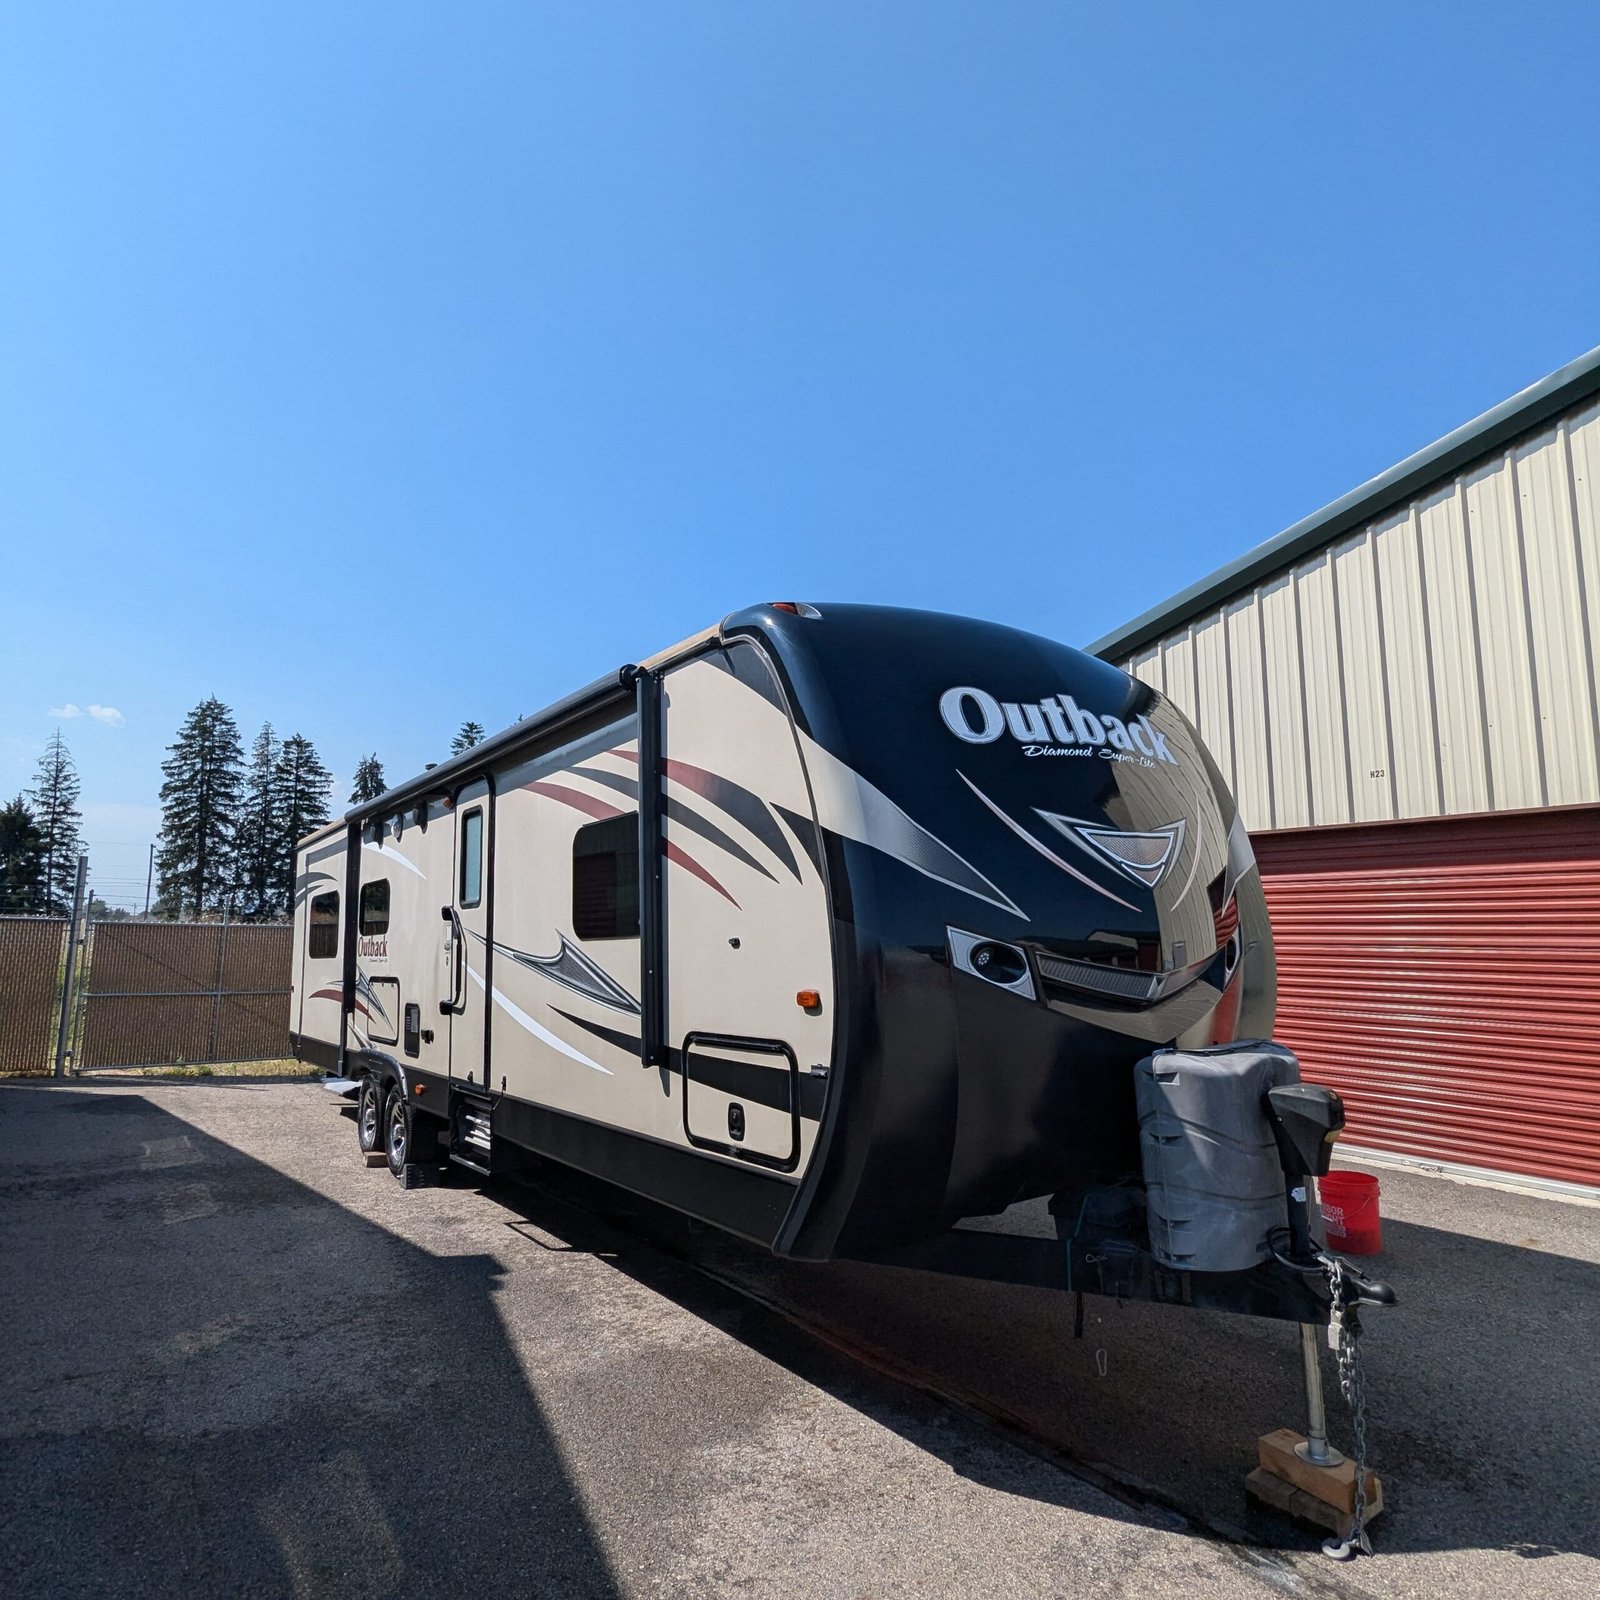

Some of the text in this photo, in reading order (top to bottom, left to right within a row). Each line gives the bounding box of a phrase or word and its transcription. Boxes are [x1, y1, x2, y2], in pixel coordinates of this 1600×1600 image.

[939, 686, 1180, 766] Outback
[1021, 745, 1093, 757] Diamond
[1370, 769, 1385, 779] H23
[358, 935, 388, 958] Outback
